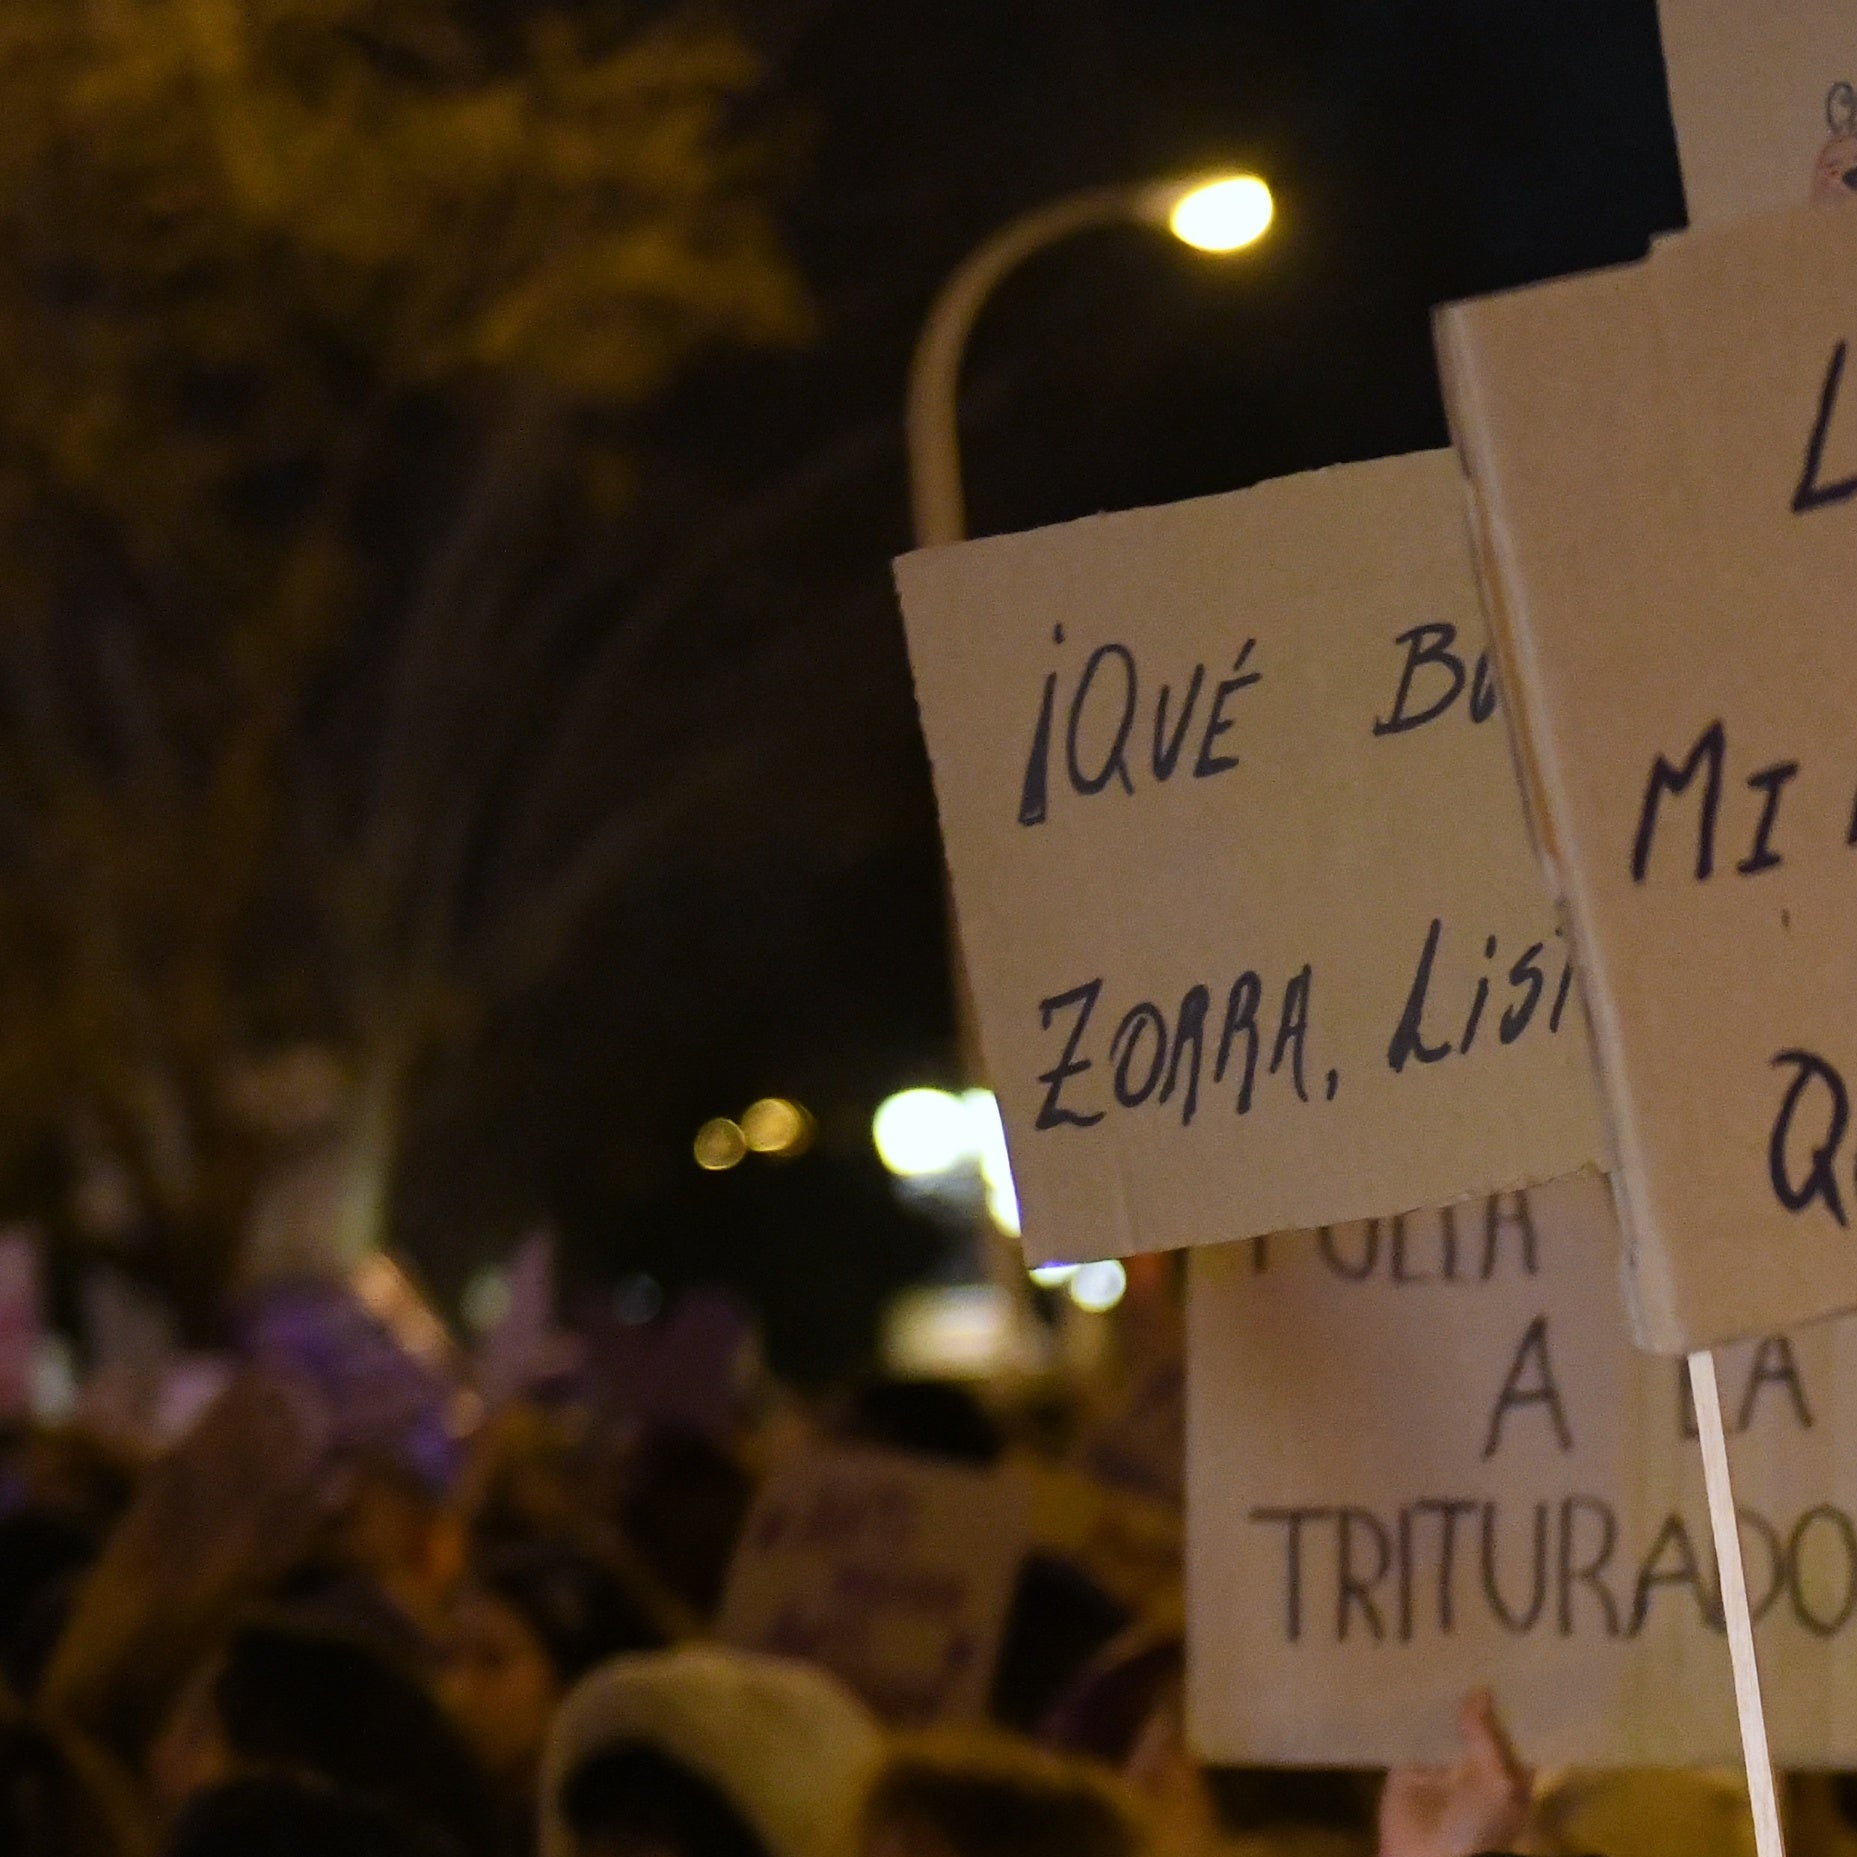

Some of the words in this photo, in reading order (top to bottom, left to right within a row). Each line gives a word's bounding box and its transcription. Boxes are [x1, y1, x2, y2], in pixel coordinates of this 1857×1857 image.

[1018, 623, 1262, 827] ¡QUÉ
[1632, 718, 1798, 883] MI
[1482, 1314, 1573, 1461] A
